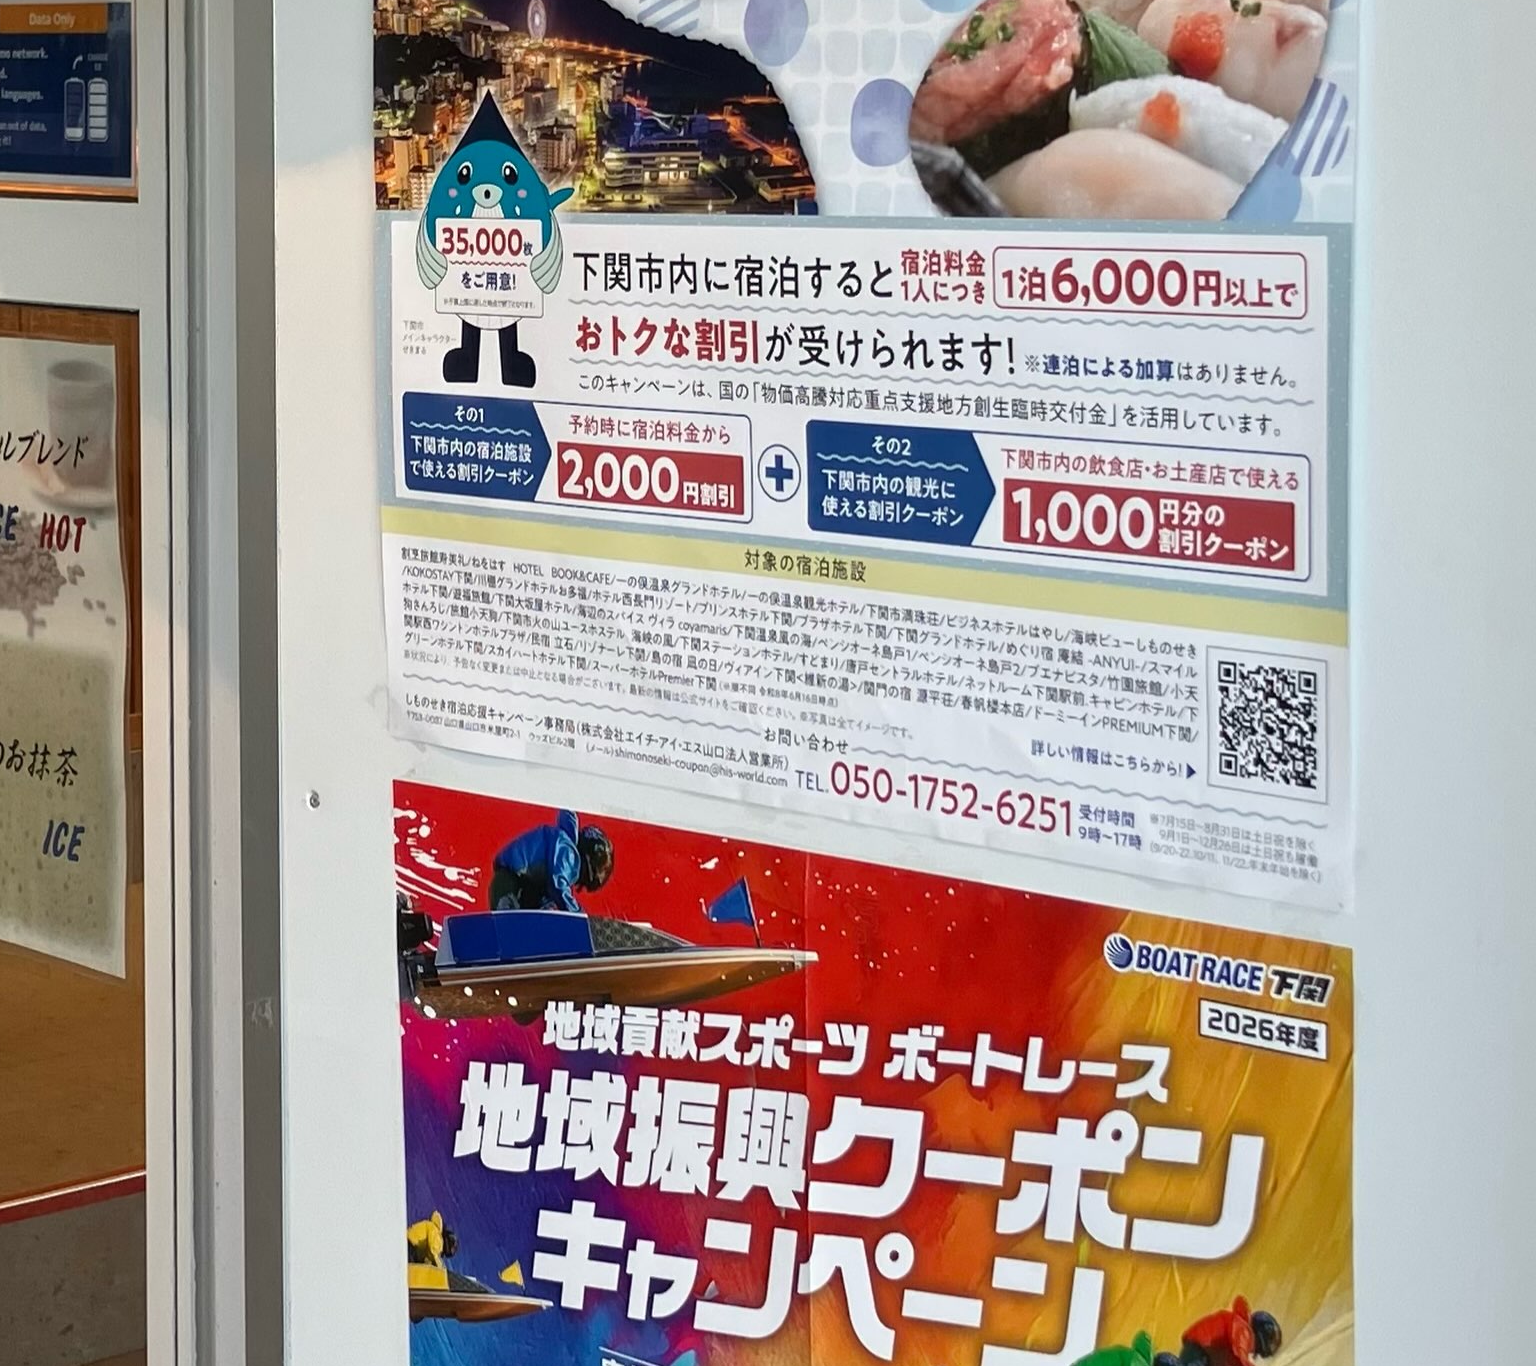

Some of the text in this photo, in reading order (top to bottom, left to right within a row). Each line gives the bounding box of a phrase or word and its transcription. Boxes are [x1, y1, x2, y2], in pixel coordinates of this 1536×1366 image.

[29, 12, 76, 29] Data Only
[441, 227, 533, 257] 35,000枚
[573, 251, 894, 300] 下関市内に宿泊すると
[900, 249, 985, 277] 宿泊料金
[461, 271, 516, 291] をご用意!
[901, 278, 986, 305] 1人につき
[1001, 258, 1298, 308] 1泊6,000円以上で
[575, 315, 1015, 375] おトクな割引が受けられます!
[1024, 353, 1297, 389] ※連泊による加算はありません。
[454, 405, 485, 424] その1
[568, 413, 732, 446] 予約時に宿泊料金から
[410, 434, 532, 464] 下関市内の宿泊施設
[871, 436, 911, 457] その2
[409, 458, 535, 487] で使える割引クーポン
[562, 451, 735, 509] 2,000円割引
[821, 468, 956, 501] 下関市内の観光に
[821, 493, 964, 528] 使える割引クーポン
[39, 512, 87, 553] HOT
[1158, 527, 1290, 563] 割引クーポン
[744, 549, 866, 583] 対象の宿泊施設
[764, 727, 848, 754] お問い合わせ
[1031, 738, 1182, 777] 詳しい情報はこちらから!
[831, 761, 1071, 836] 050-1752-6251
[1078, 804, 1135, 828] 受付時間
[43, 819, 85, 863] ICE
[1136, 944, 1332, 1004] BOAT RACE 下関
[1207, 1008, 1319, 1052] 2026年度
[542, 999, 1171, 1104] 地域貢献スポーツ ボートレース
[453, 1059, 1264, 1262] 地域振興クーポン
